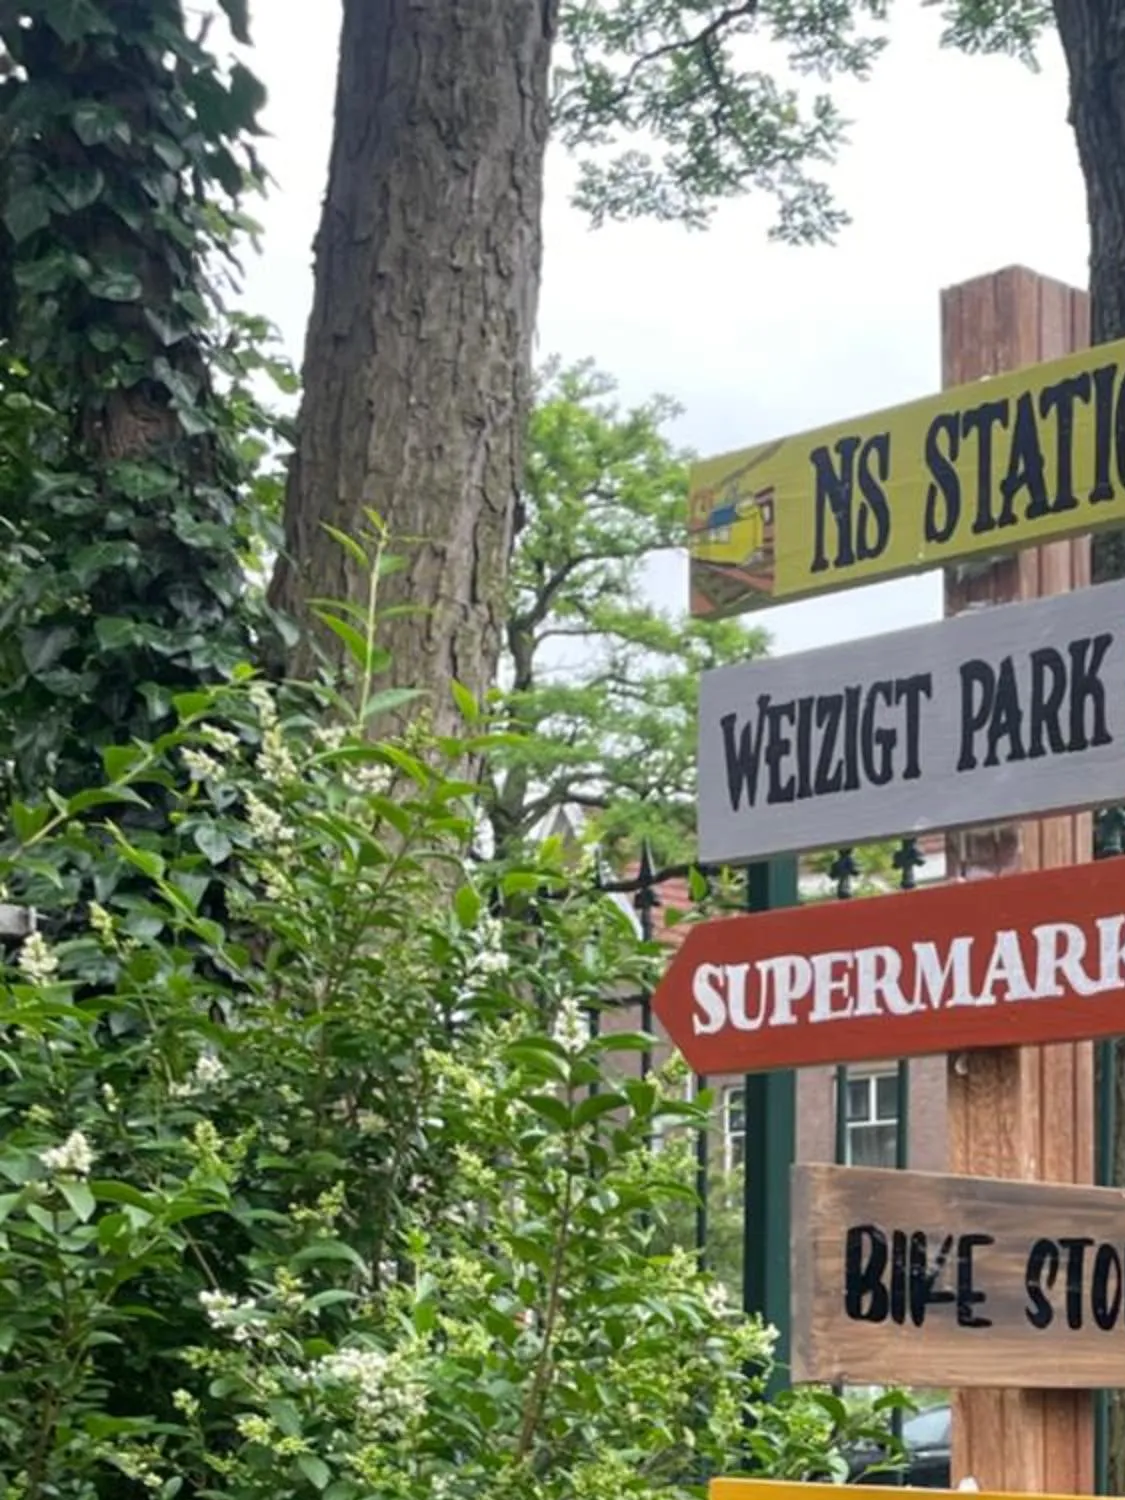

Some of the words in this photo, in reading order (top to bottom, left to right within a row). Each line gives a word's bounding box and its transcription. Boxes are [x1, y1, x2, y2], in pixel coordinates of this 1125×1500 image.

[810, 431, 892, 575] NS
[720, 672, 933, 812] WEIZIGT
[956, 633, 1114, 773] PARK
[844, 1224, 995, 1329] BIKE
